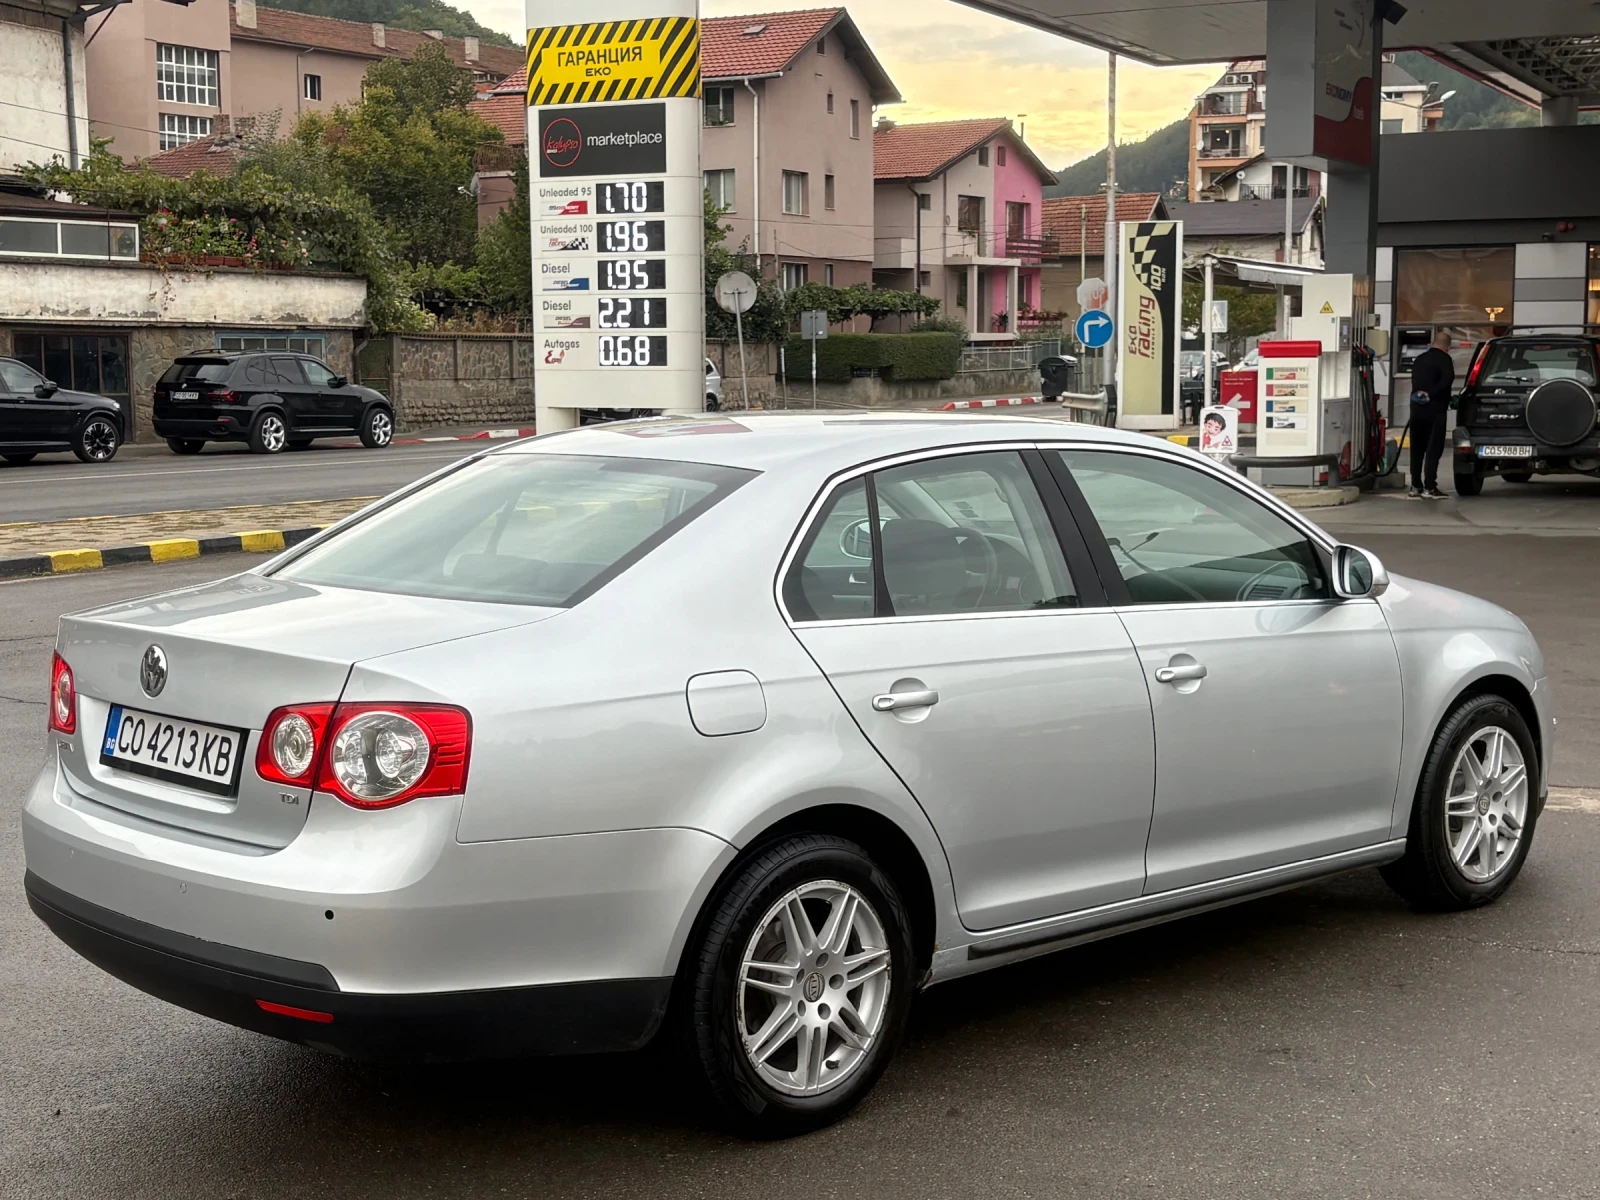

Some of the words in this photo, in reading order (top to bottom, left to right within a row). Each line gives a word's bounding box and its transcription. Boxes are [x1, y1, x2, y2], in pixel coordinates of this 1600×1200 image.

[557, 46, 643, 67] ГАРАНЦИЯ
[587, 131, 663, 149] marketplace
[539, 187, 579, 198] Unleaded
[581, 186, 592, 197] 95
[605, 182, 648, 213] 1.70
[540, 225, 578, 235] Unleaded
[579, 224, 593, 233] 100
[605, 221, 649, 252] 1.96
[541, 263, 570, 274] Diesel
[606, 260, 649, 290] 1.95
[1150, 264, 1162, 291] 100
[542, 300, 572, 311] Diesel
[599, 298, 650, 328] 2.21
[1137, 295, 1156, 359] racing
[543, 339, 580, 351] Autogas
[599, 336, 650, 366] 0.68
[105, 737, 115, 749] BG
[147, 721, 200, 769] 4213
[278, 791, 300, 806] TDI
